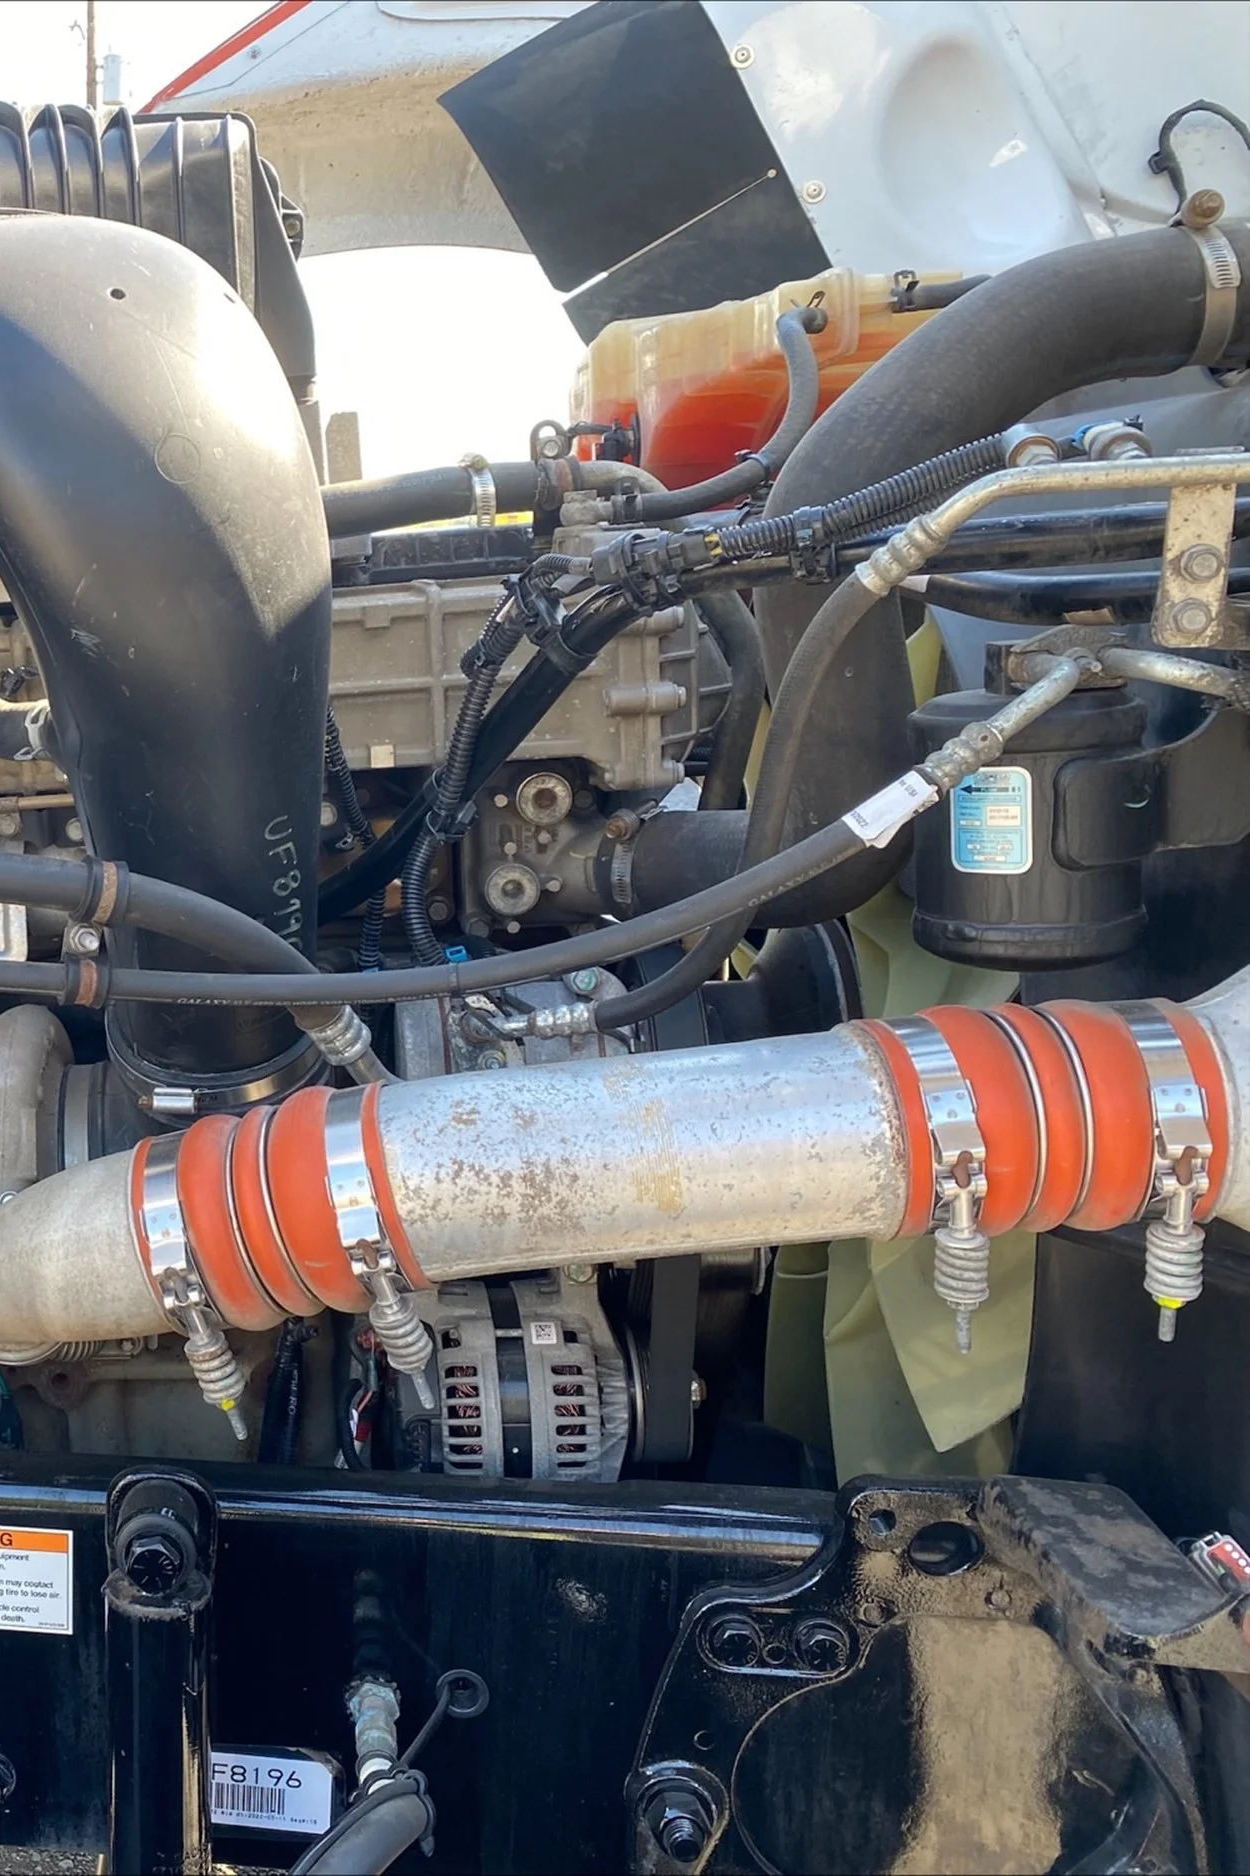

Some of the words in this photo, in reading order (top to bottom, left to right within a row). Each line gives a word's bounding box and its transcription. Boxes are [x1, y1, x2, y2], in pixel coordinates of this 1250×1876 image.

[5, 1580, 22, 1588] may
[6, 1588, 19, 1596] tire
[20, 1589, 29, 1597] to
[30, 1590, 48, 1598] lose
[11, 1605, 40, 1613] control
[1, 1614, 25, 1623] death.
[212, 1763, 302, 1788] F8196
